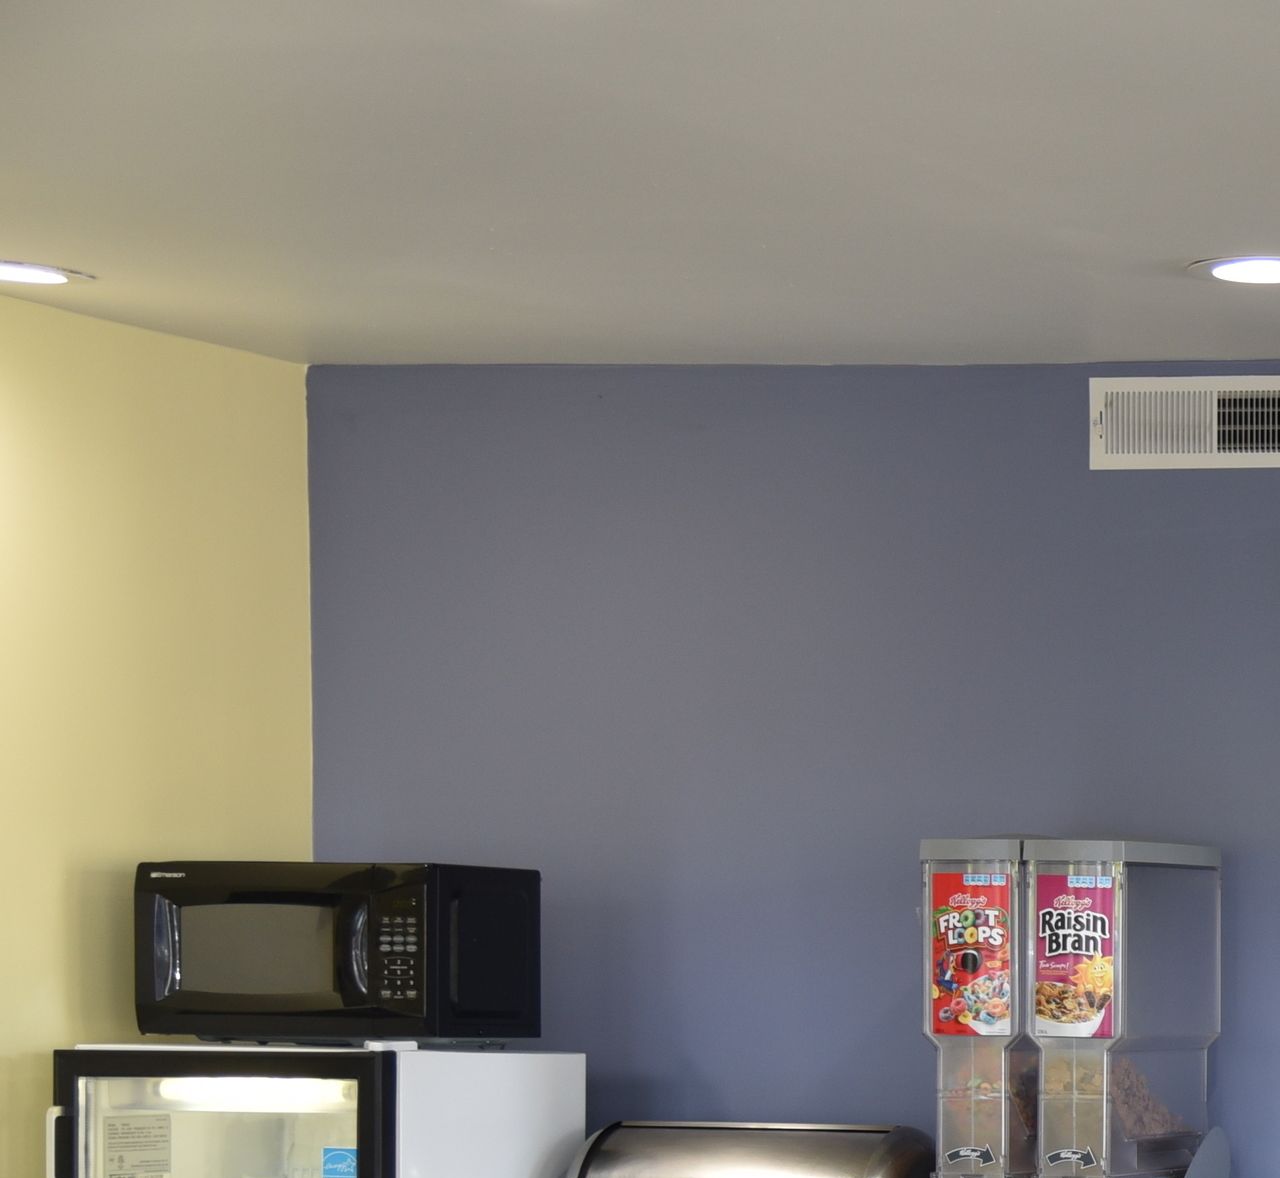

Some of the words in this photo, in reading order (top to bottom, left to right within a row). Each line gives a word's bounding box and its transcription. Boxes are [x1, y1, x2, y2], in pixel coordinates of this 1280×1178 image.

[949, 893, 987, 908] Kellogg's
[1053, 895, 1092, 910] Kellogg's
[939, 909, 999, 933] FROOT
[1041, 910, 1108, 937] Raisin
[947, 926, 1004, 945] LOOPS
[1047, 931, 1100, 954] Bran
